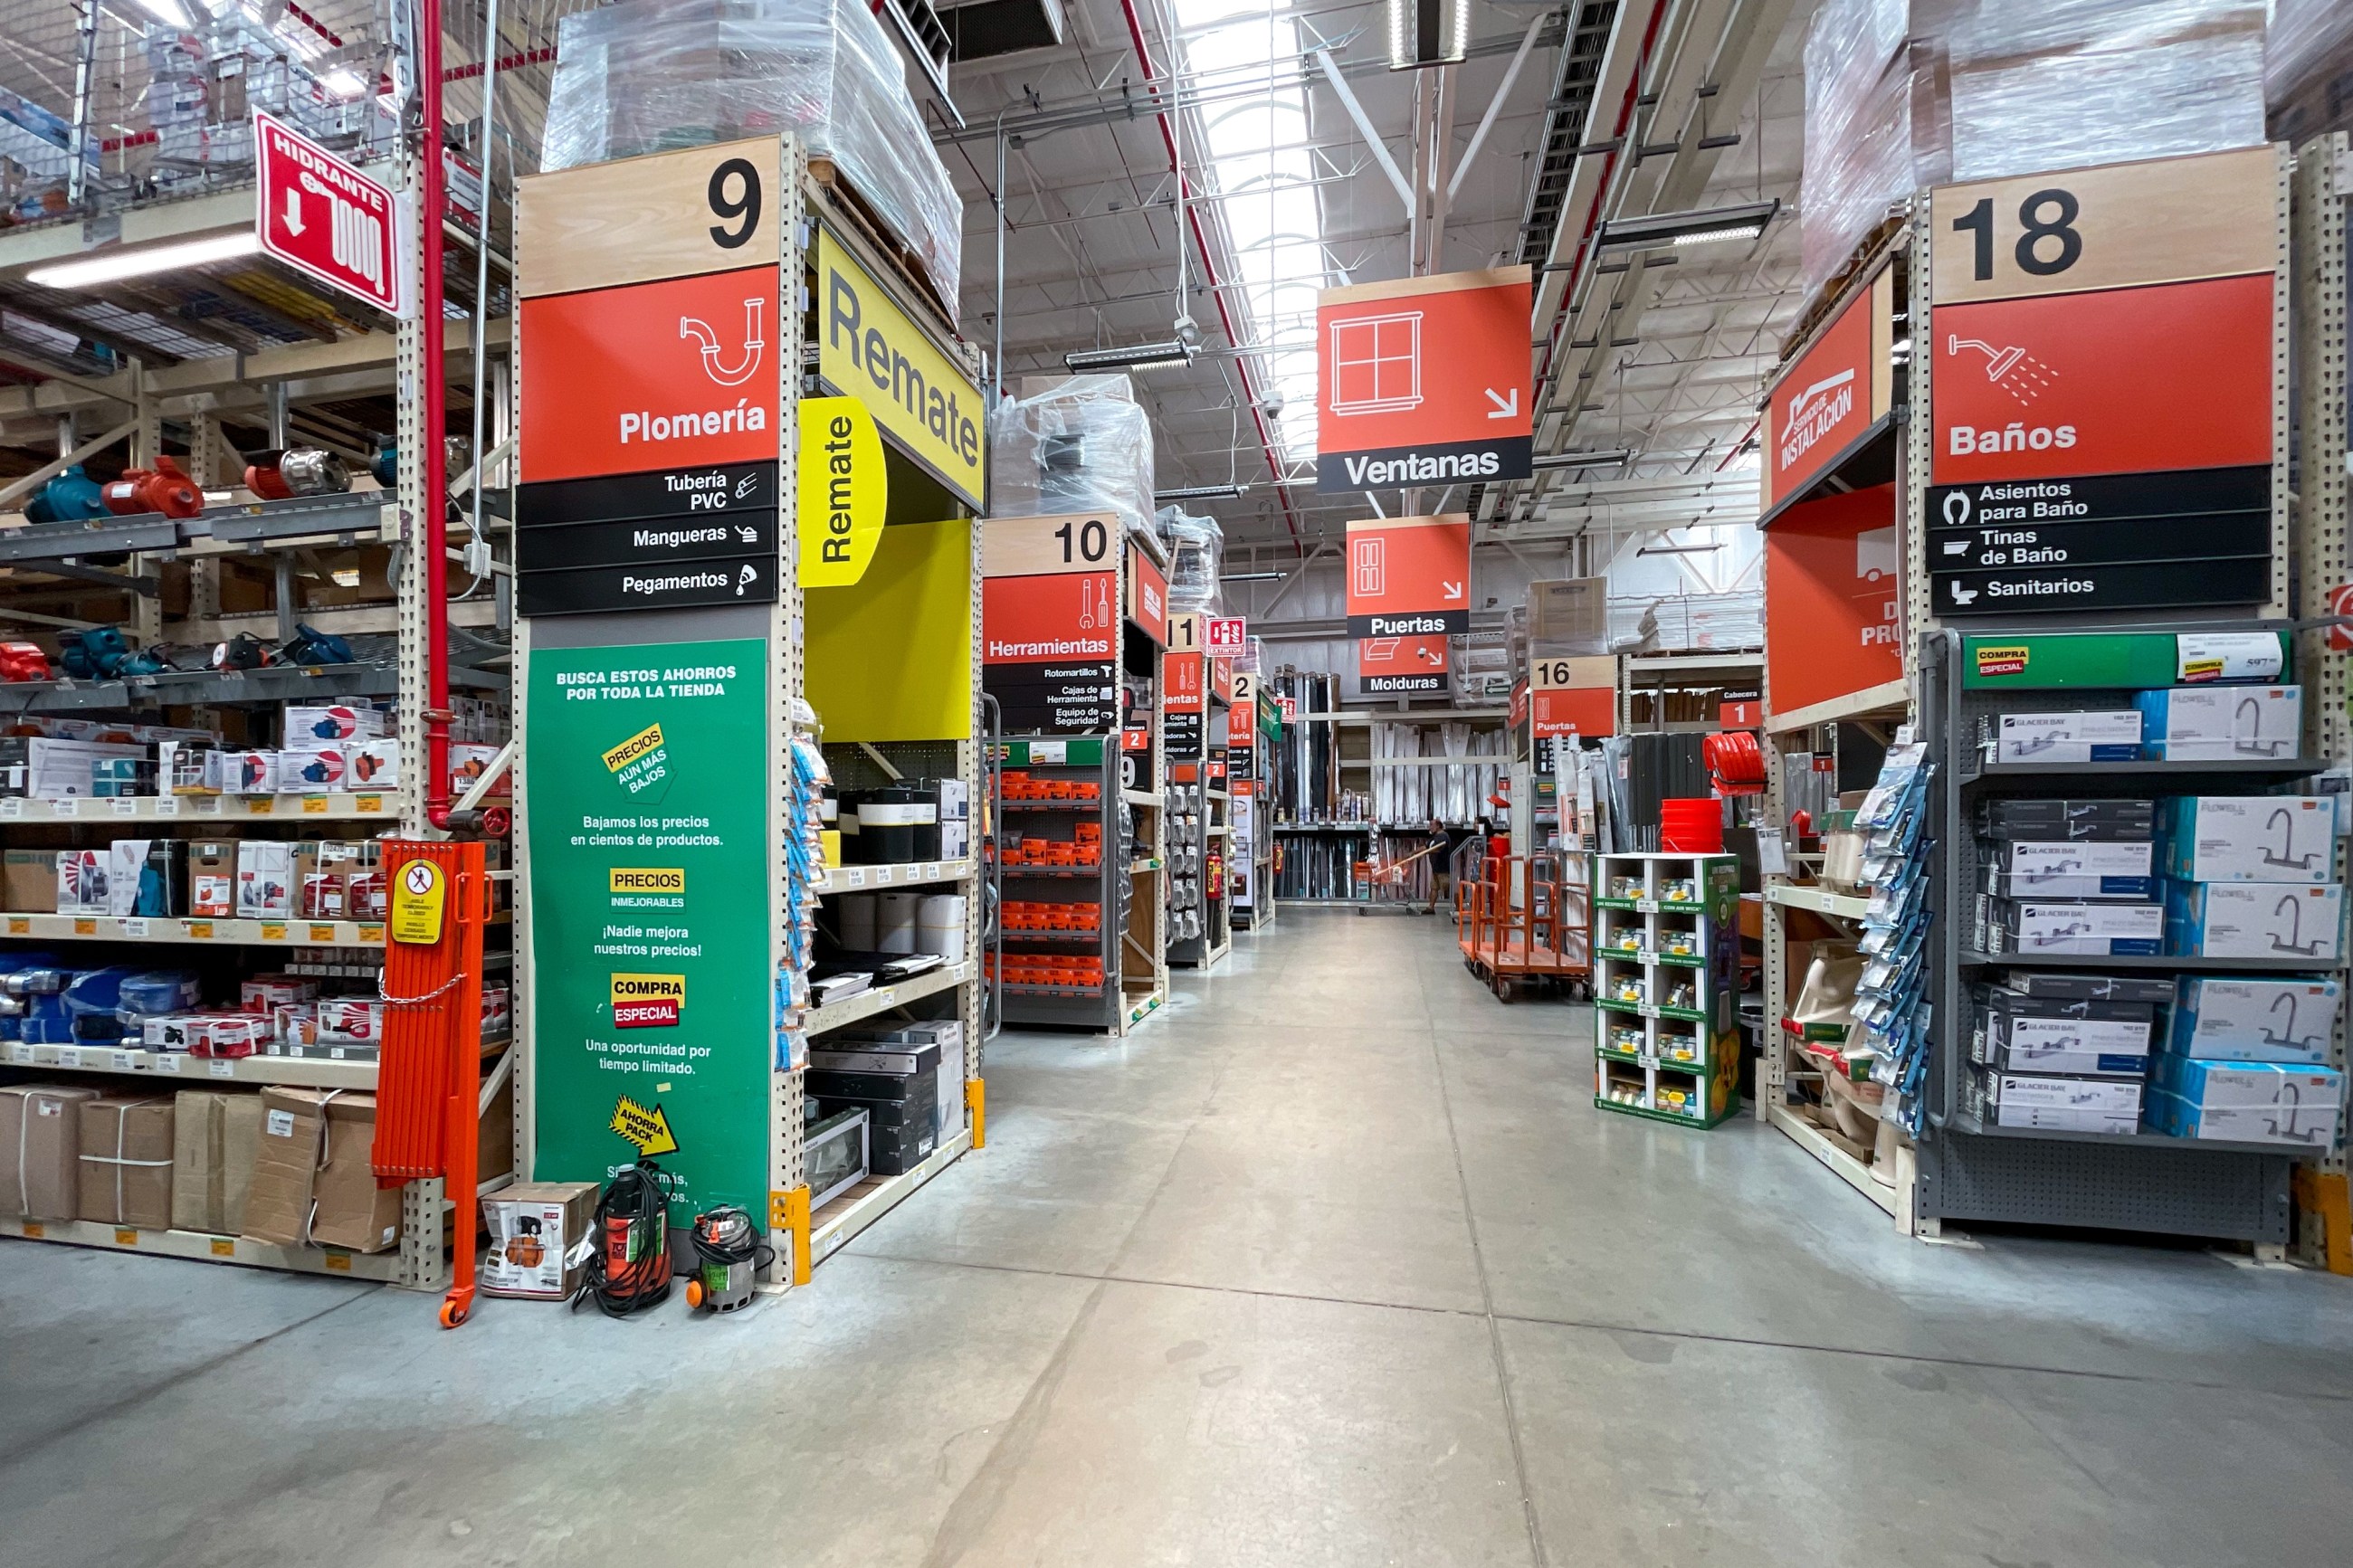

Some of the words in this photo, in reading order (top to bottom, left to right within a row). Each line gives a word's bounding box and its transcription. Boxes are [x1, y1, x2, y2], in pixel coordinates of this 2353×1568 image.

[274, 133, 383, 213] HIDRANTE
[708, 158, 762, 249] 9
[1952, 188, 2082, 276] 18
[830, 266, 978, 468] Remate
[620, 399, 766, 443] Plomería
[1782, 385, 1852, 470] INSTALACIÓN
[1949, 422, 2077, 455] Baños
[1345, 451, 1500, 486] Ventanas
[664, 470, 727, 494] Tubería
[823, 415, 852, 563] Remate
[1978, 482, 2071, 500] Asientos
[691, 491, 727, 510] PVC
[1979, 506, 2026, 524] para
[2034, 499, 2088, 518] Baño
[634, 527, 727, 549] Mangueras
[1055, 520, 1107, 563] 10
[1980, 529, 2036, 546] Tinas
[1980, 549, 2006, 565] de
[2013, 546, 2067, 564] Baño
[623, 573, 728, 596] Pegamentos
[1987, 578, 2094, 597] Sanitarios
[1884, 601, 1899, 621] D
[1371, 617, 1445, 635] Puertas
[1862, 622, 1900, 646] PRO
[989, 638, 1109, 656] Herramientas
[1210, 646, 1243, 654] EXTINTOR
[1979, 651, 2026, 659] COMPRA
[557, 671, 605, 685] BUSCA
[610, 669, 659, 684] ESTOS
[662, 665, 737, 681] AHORROS
[1044, 668, 1098, 678] Rotomartillos
[1538, 662, 1569, 685] 16
[1979, 663, 2023, 673] ESPECIAL
[567, 686, 597, 701] POR
[600, 686, 642, 699] TODA
[645, 685, 665, 698] LA
[669, 683, 725, 697] TIENDA
[1062, 686, 1086, 696] Cajas
[1086, 686, 1098, 694] de
[1235, 677, 1249, 698] 2
[1370, 676, 1438, 692] Molduras
[1047, 695, 1098, 704] Herramienta
[1164, 694, 1198, 704] ientas
[1724, 690, 1758, 698] Cabecera
[1055, 708, 1086, 717] Equipo
[1055, 716, 1099, 727] Seguridad
[1169, 714, 1187, 722] Cajas
[1735, 705, 1745, 723] 1
[1537, 722, 1576, 731] Puertas
[1130, 733, 1138, 746] 2
[606, 730, 662, 768] PRECIOS
[618, 764, 642, 785] AÚN
[641, 748, 668, 774] MÁS
[1213, 765, 1220, 775] 2
[628, 766, 667, 794] BAJOS
[583, 816, 636, 831] Bajamos
[640, 816, 659, 828] los
[662, 815, 710, 831] precios
[571, 834, 586, 846] en
[589, 832, 634, 846] cientos
[637, 832, 653, 846] de
[656, 832, 723, 848] productos.
[614, 874, 681, 888] PRECIOS
[611, 897, 684, 908] INMEJORABLES
[602, 925, 643, 940] ¡Nadie
[646, 927, 689, 942] mejora
[594, 943, 648, 955] nuestros
[652, 944, 701, 959] precios!
[614, 981, 683, 995] COMPRA
[615, 1005, 676, 1022] ESPECIAL
[586, 1039, 608, 1052] Una
[611, 1042, 686, 1060] oportunidad
[690, 1046, 710, 1060] por
[599, 1058, 639, 1073] tiempo
[642, 1060, 696, 1075] limitado.
[2016, 1082, 2050, 1091] GLACIER
[2051, 1084, 2066, 1092] BAY
[620, 1107, 665, 1137] AHORRA
[625, 1122, 653, 1143] PACK
